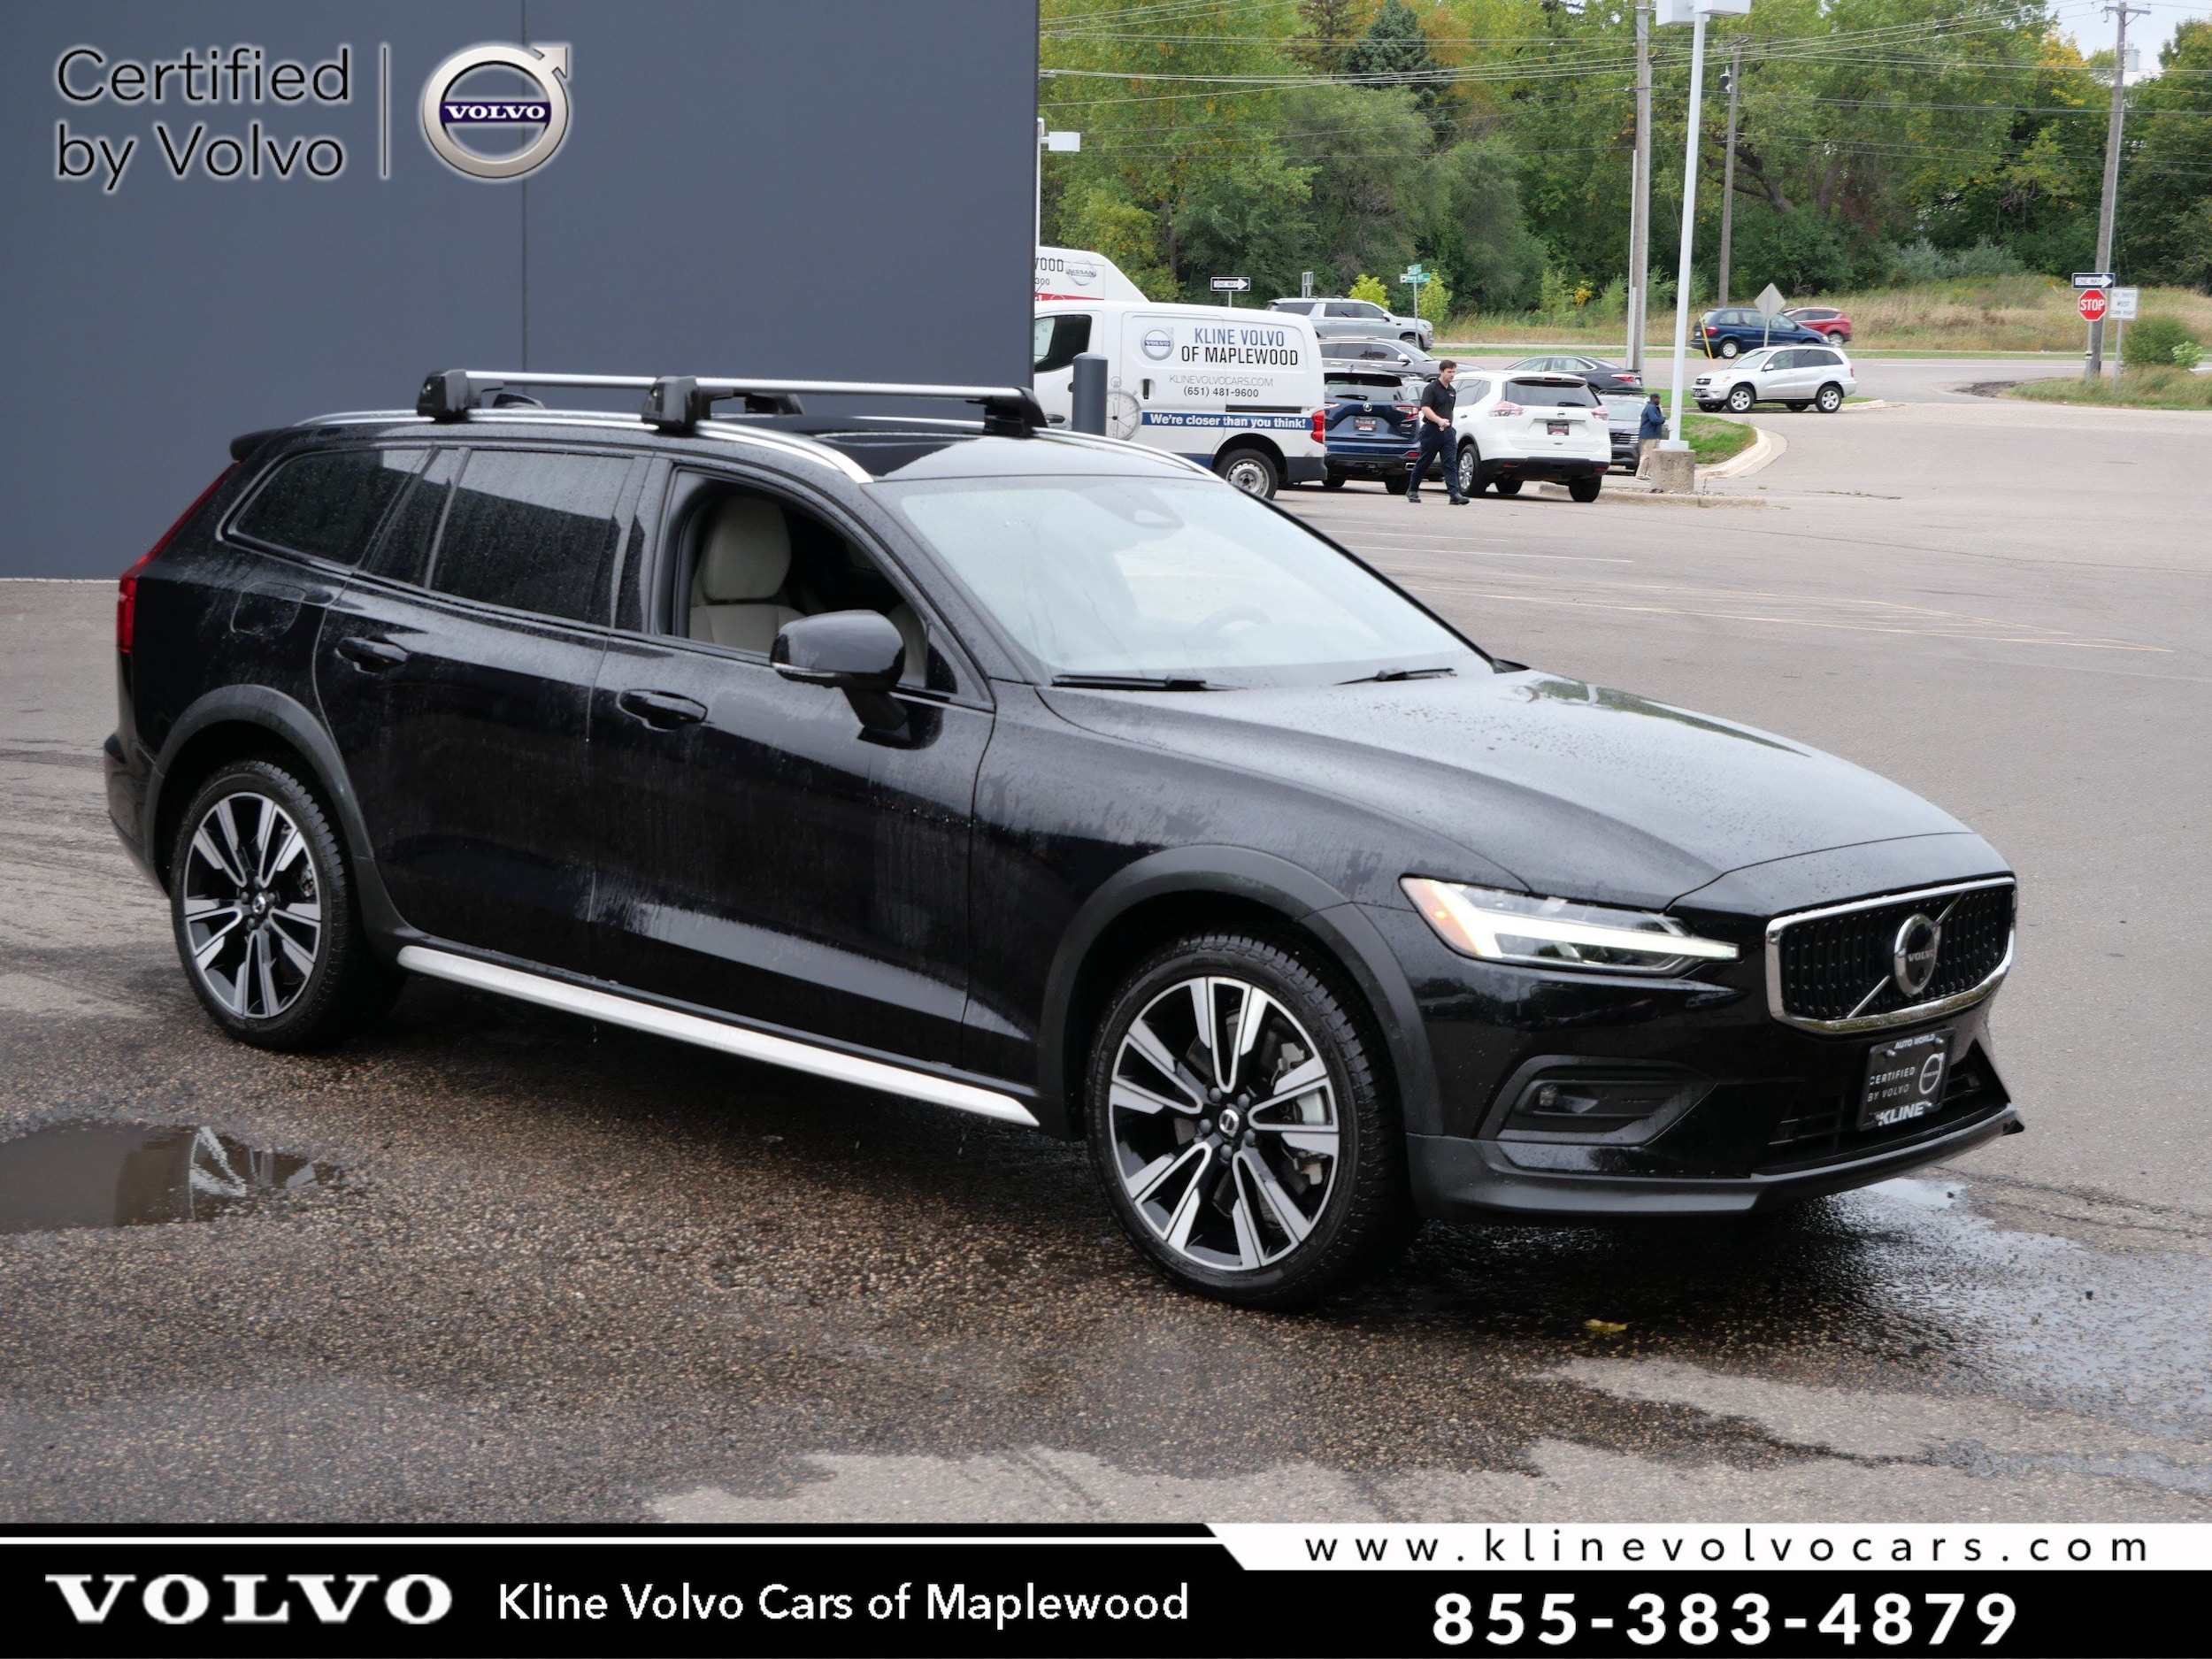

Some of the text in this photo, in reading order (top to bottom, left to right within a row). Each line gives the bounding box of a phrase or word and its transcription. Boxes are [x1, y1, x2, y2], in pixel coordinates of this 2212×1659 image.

[2079, 298, 2105, 311] STOP
[1194, 327, 1285, 347] KLINE VOLVO
[1181, 345, 1298, 365] OF MAPLEWOOD
[1169, 374, 1273, 387] KLINEVOLVOCARS.COM
[1183, 386, 1259, 397] (651) 481-9600
[1150, 413, 1306, 428] We're closer than you think!
[1894, 1033, 1936, 1049] AUTO WORLD
[1869, 1066, 1916, 1086] CERTIFIED
[1867, 1083, 1909, 1102] BY VOLVO
[1879, 1101, 1924, 1125] KLINE
